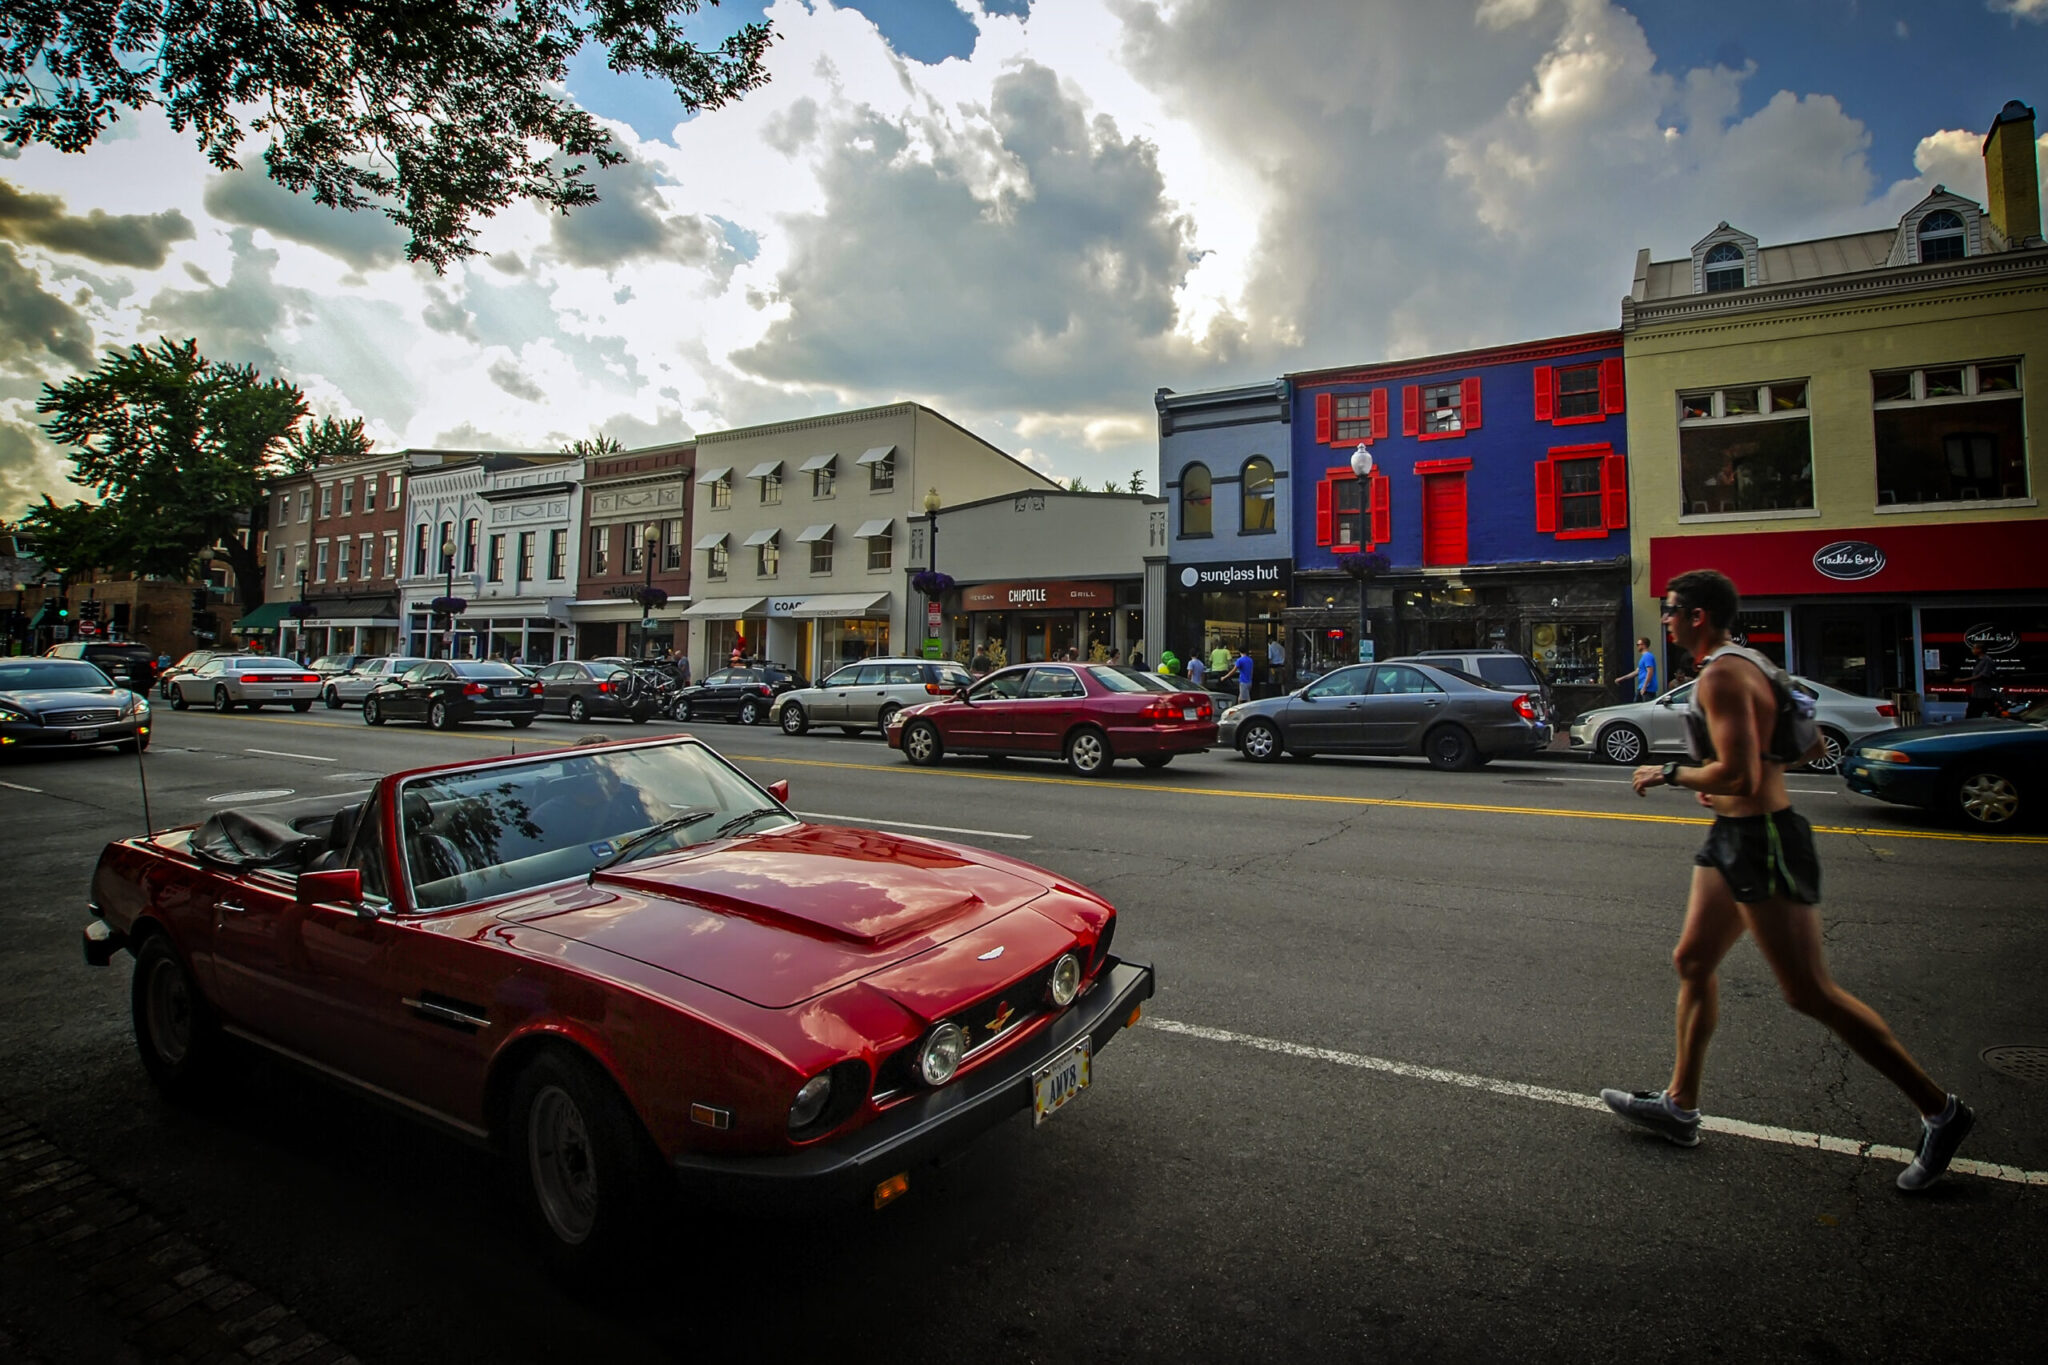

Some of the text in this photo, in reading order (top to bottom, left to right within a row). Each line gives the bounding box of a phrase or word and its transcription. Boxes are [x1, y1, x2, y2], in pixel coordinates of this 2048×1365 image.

[1855, 554, 1875, 565] Box
[1200, 565, 1279, 585] sunglass hut
[774, 601, 805, 611] COAC
[1050, 1063, 1077, 1104] AMV8
